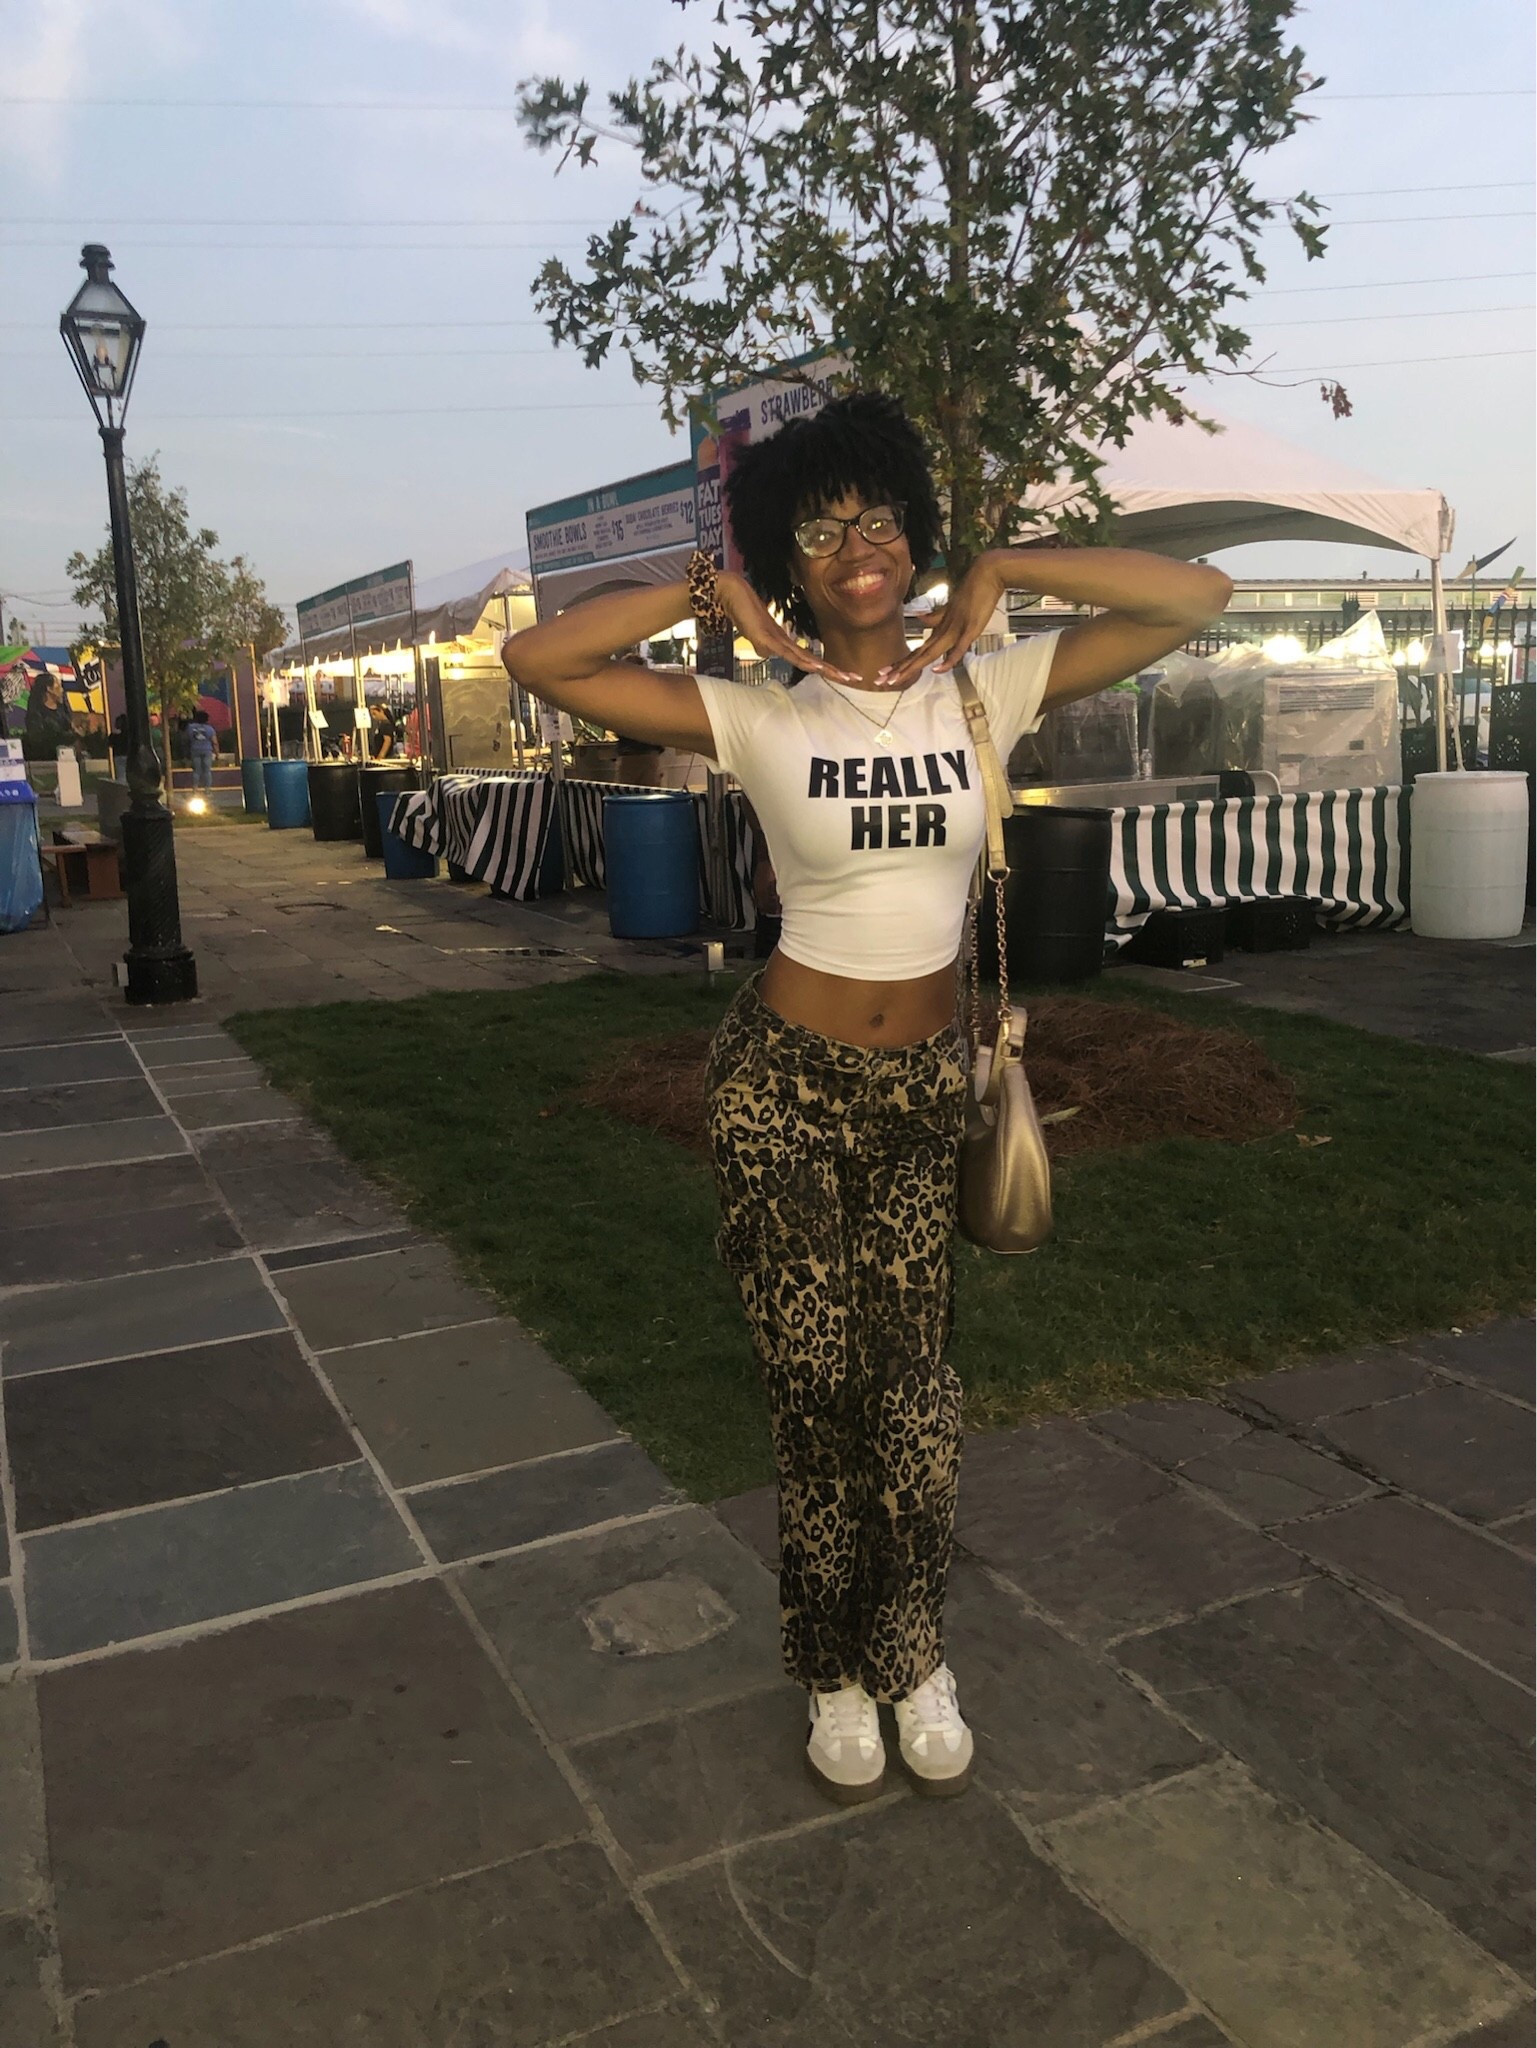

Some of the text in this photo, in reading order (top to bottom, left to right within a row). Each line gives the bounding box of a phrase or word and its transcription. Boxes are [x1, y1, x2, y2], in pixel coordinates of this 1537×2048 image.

[761, 377, 834, 425] STRAWBERR
[698, 479, 720, 508] FAT
[680, 500, 693, 524] $12
[699, 504, 722, 529] TUES
[533, 522, 587, 551] SMOOTHIE BOWLS
[611, 520, 624, 541] $15
[700, 525, 722, 550] DAY
[808, 750, 970, 798] REALLY
[851, 803, 946, 850] HER
